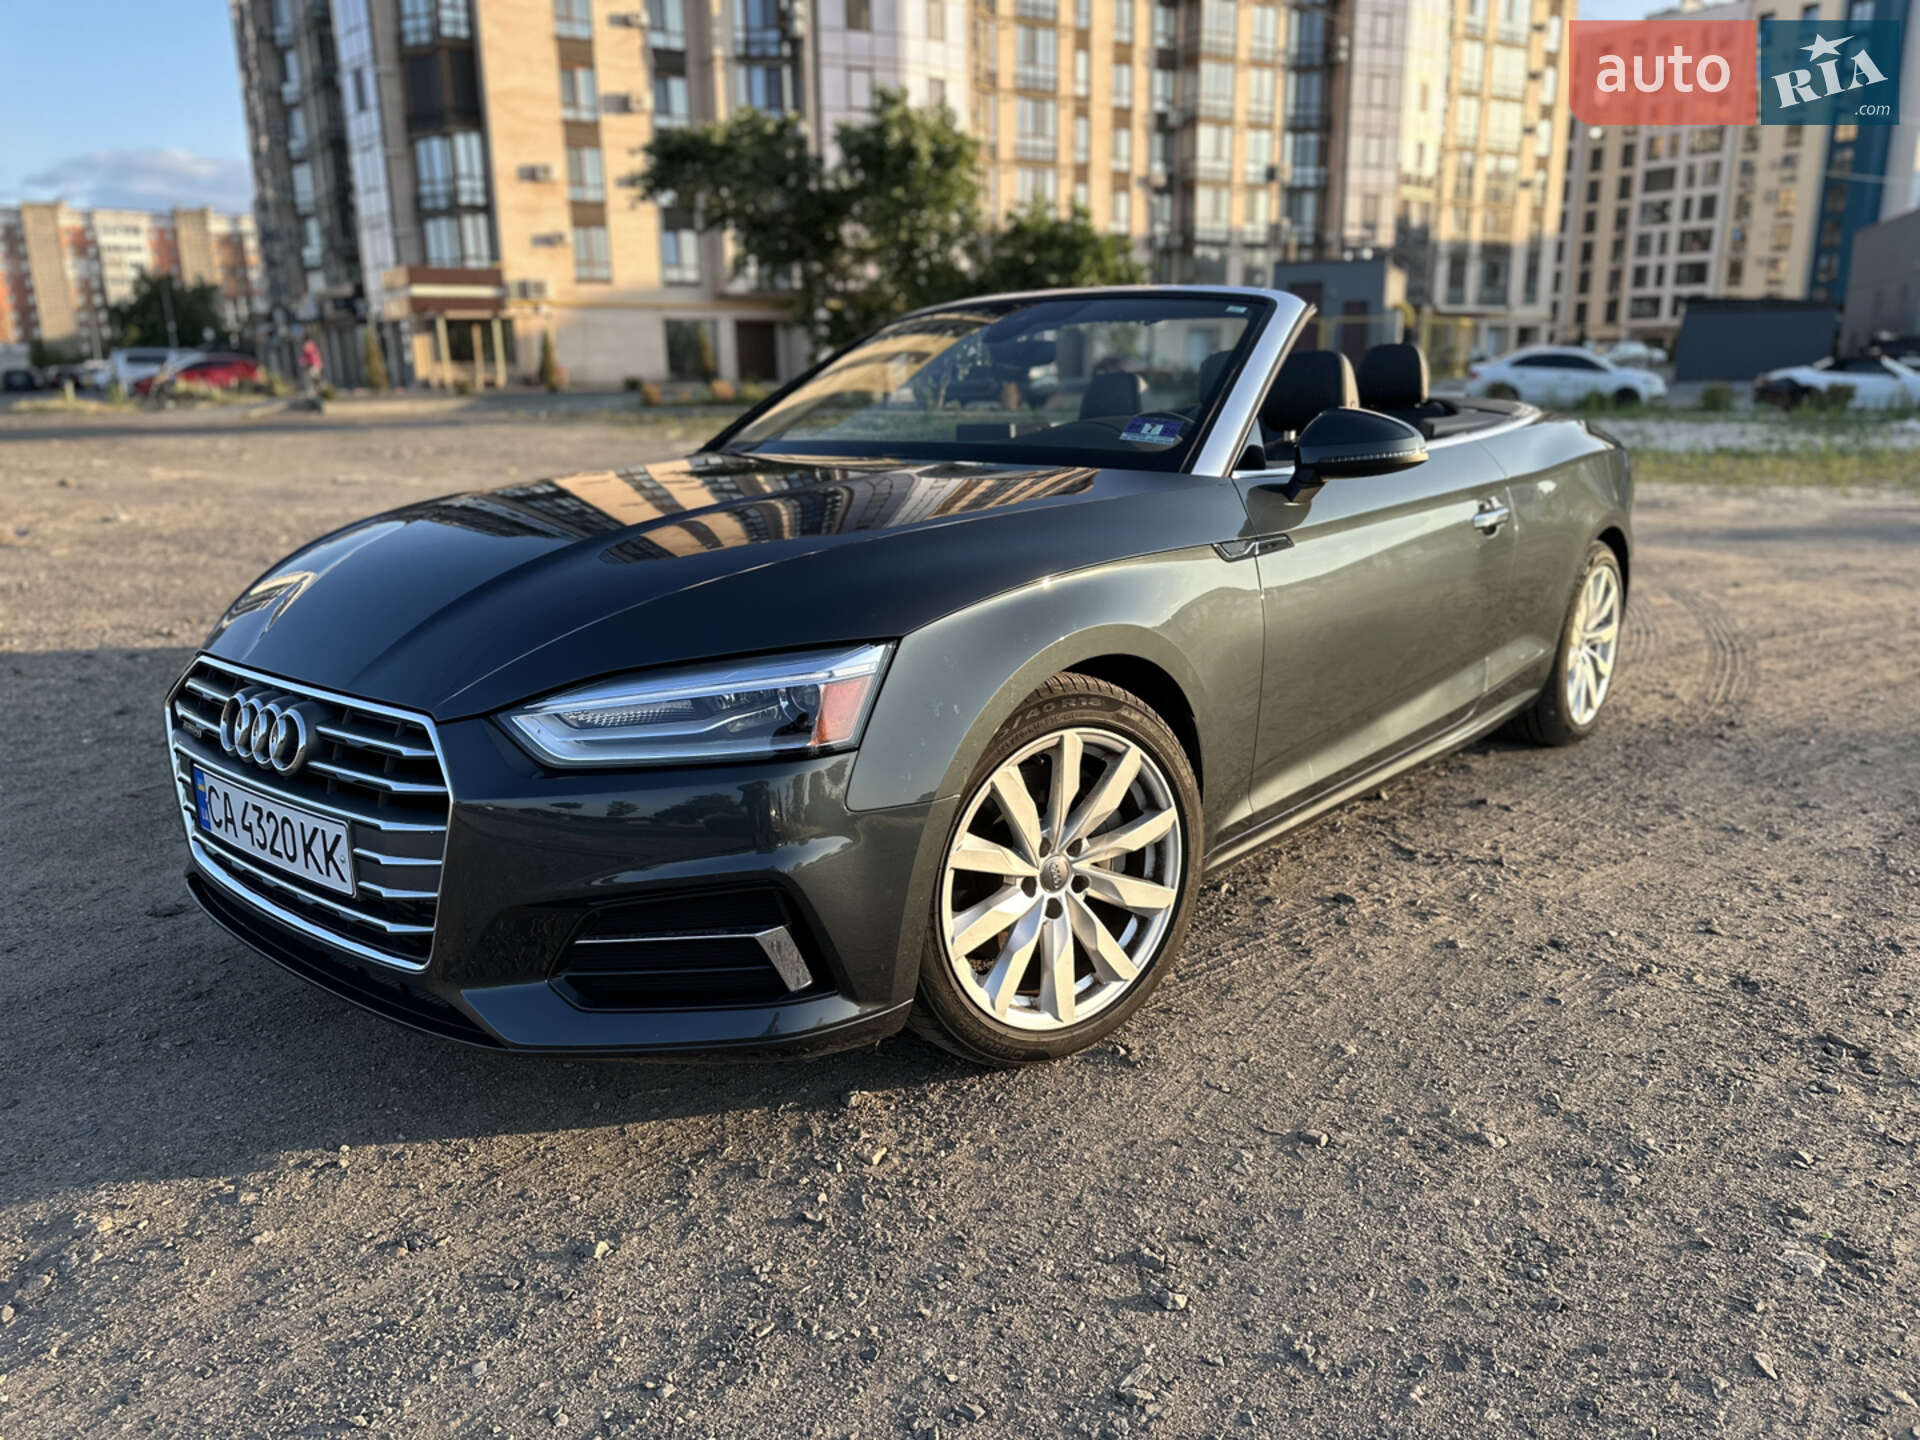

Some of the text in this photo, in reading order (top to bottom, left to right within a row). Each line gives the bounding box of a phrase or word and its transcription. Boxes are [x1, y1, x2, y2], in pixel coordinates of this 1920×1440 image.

[208, 785, 348, 884] CA 4320 KK
